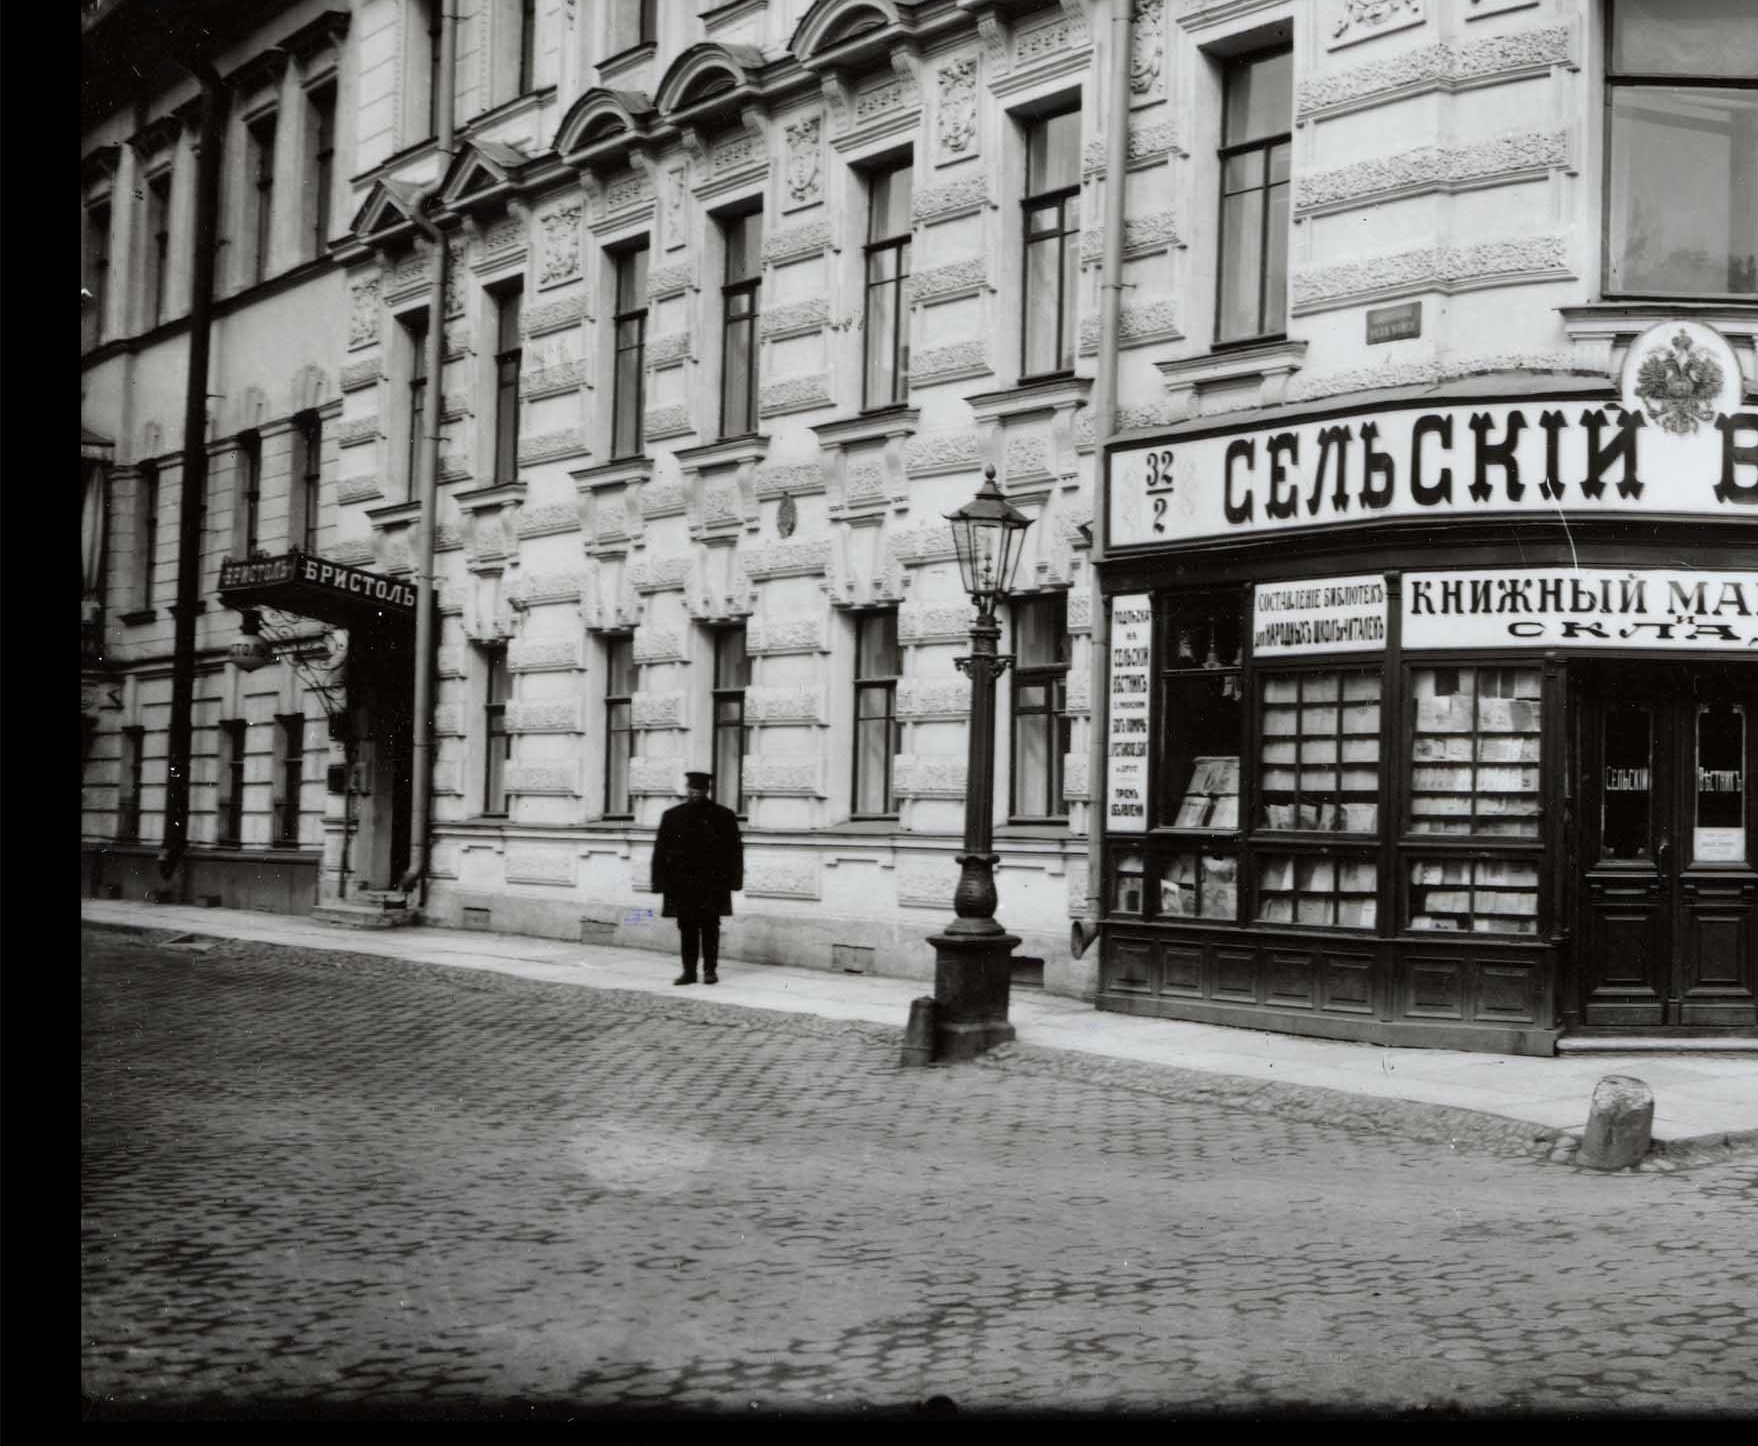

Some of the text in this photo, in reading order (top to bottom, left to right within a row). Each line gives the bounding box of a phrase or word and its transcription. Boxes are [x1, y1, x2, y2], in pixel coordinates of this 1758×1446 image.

[1146, 450, 1174, 486] 32
[1224, 404, 1648, 526] СЕЛЬСКІЙ
[1153, 497, 1167, 533] 2
[1410, 573, 1648, 614] КНИЖНЫЙ
